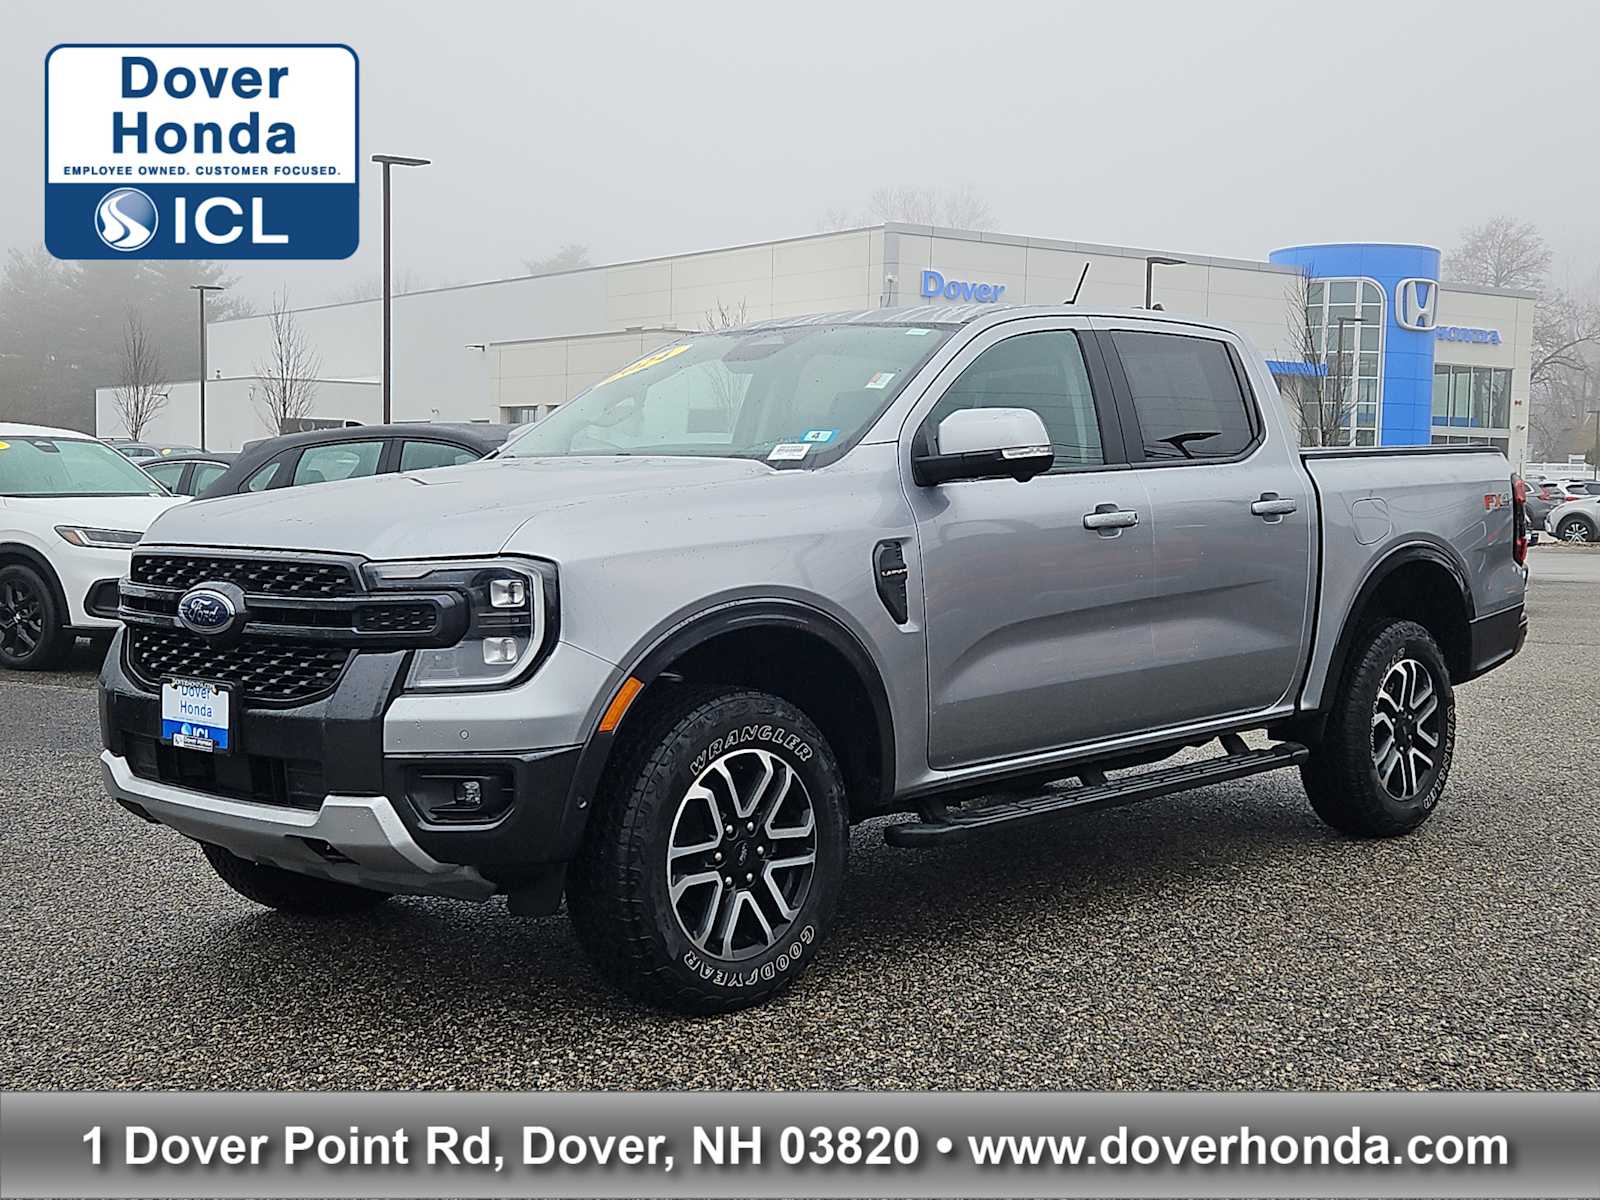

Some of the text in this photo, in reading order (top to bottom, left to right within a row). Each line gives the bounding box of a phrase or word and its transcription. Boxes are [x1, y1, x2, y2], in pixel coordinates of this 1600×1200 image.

[920, 270, 1005, 303] Dover
[188, 598, 219, 623] Ford
[181, 685, 211, 699] Dover
[180, 700, 213, 718] Honda
[689, 724, 814, 777] WRANGLER
[683, 924, 815, 988] GOODYEAR
